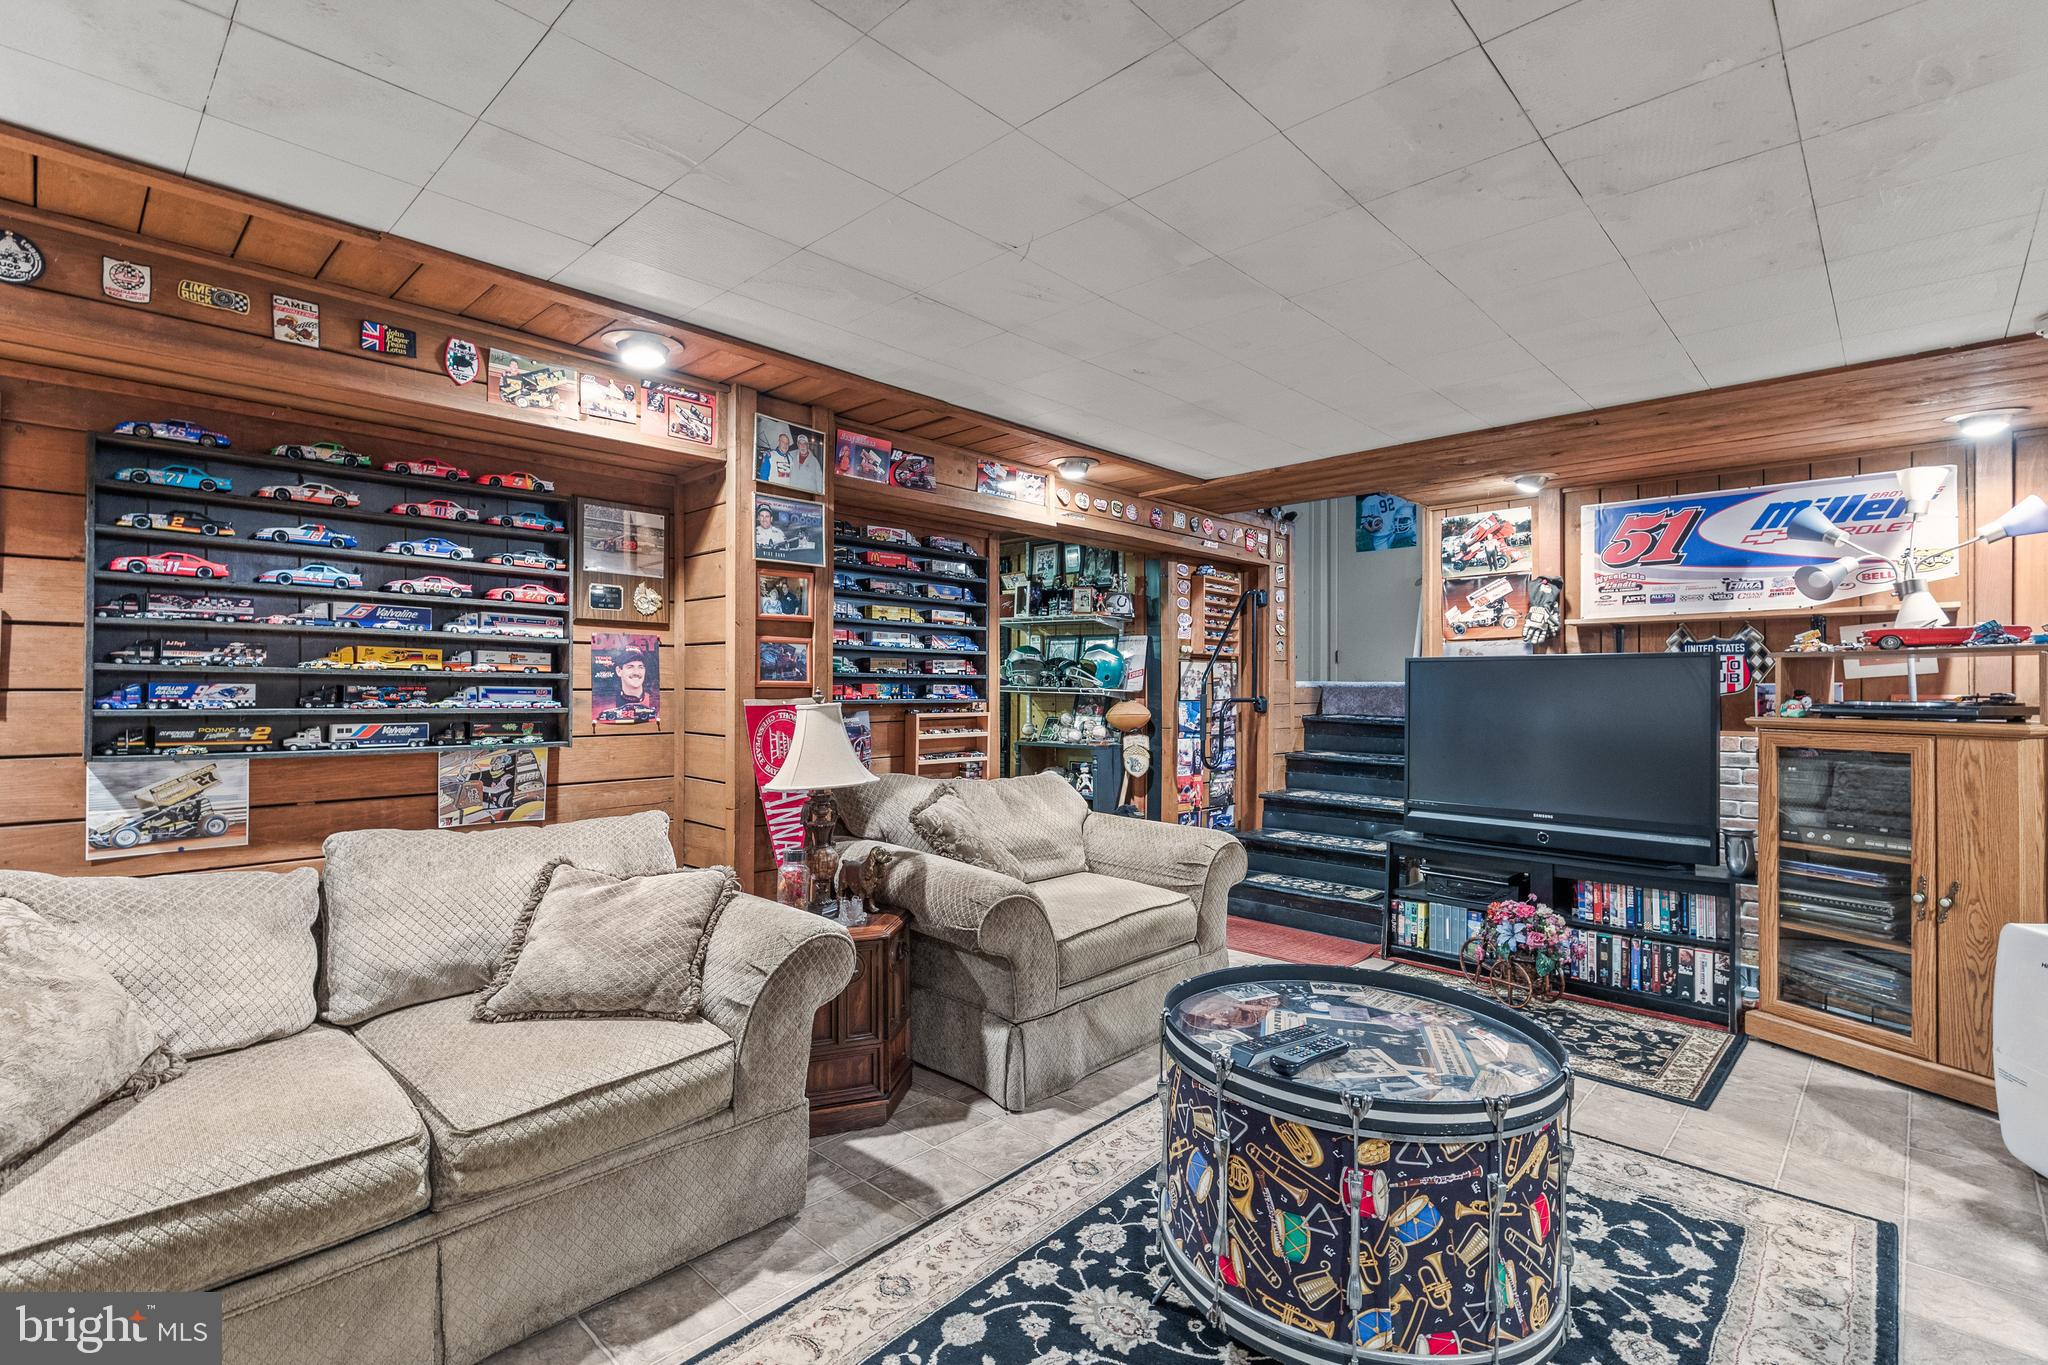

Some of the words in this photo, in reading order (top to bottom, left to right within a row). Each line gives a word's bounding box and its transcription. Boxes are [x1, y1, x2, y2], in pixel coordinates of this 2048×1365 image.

[181, 281, 213, 296] LIME
[181, 290, 213, 305] ROCK
[274, 298, 317, 313] CAMEL
[386, 328, 405, 338] John
[386, 335, 410, 345] Player
[386, 341, 407, 350] Team
[386, 346, 407, 355] Lotus
[168, 425, 187, 437] 75
[423, 465, 437, 473] 15
[165, 472, 184, 484] 71
[307, 489, 320, 500] 7
[1379, 497, 1396, 513] 92
[171, 515, 185, 527] 2
[1601, 507, 1704, 568] 51
[165, 561, 179, 572] 11
[1861, 571, 1895, 581] BELL
[351, 605, 372, 618] 6
[376, 607, 418, 619] Valvoline
[1684, 644, 1714, 653] UNITED
[1715, 643, 1745, 653] STATES
[1720, 660, 1740, 670] TO
[1720, 673, 1740, 683] UB
[250, 726, 272, 740] 2
[382, 726, 419, 735] Valvoline
[192, 771, 219, 787] 27
